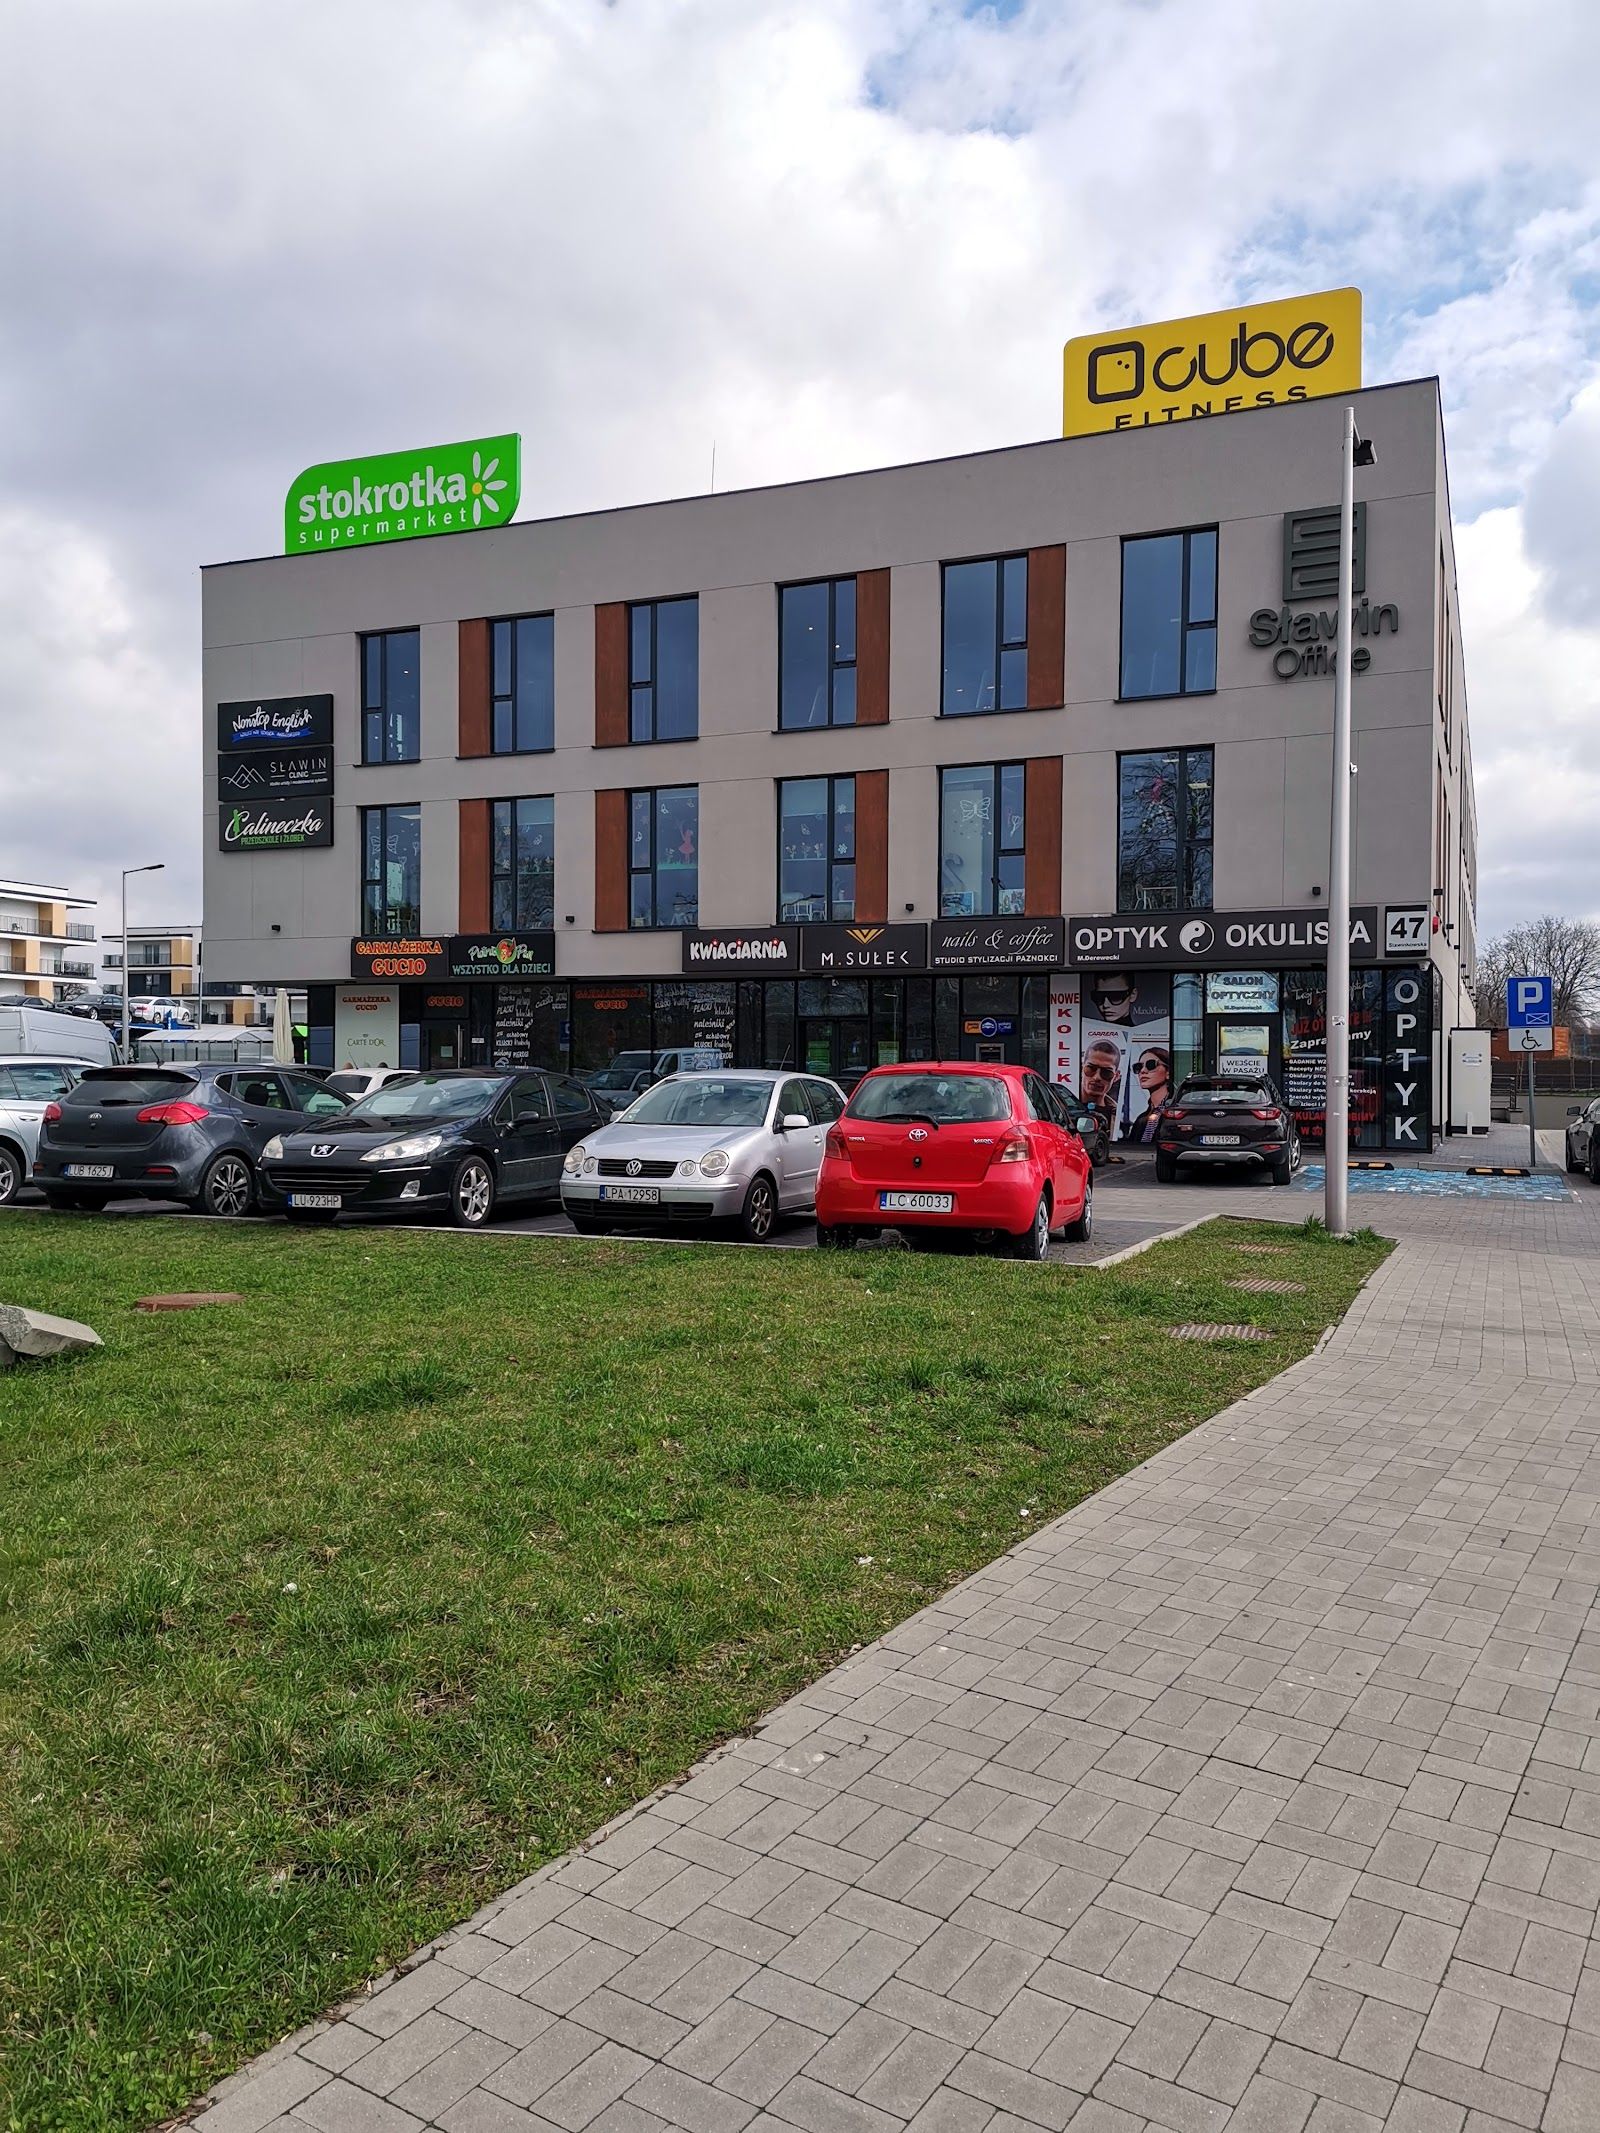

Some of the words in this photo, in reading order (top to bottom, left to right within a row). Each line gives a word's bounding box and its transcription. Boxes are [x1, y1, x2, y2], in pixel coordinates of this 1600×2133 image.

[1153, 321, 1334, 393] cube
[1115, 385, 1308, 429] FITNESS
[299, 465, 467, 524] stokrotka
[300, 507, 467, 544] supermarket
[232, 706, 269, 732] Nonstop
[272, 708, 312, 733] English
[270, 758, 327, 773] SŁAWIN
[288, 771, 309, 779] CLINIC
[224, 809, 325, 842] Calineczka
[1391, 917, 1424, 939] 47
[942, 929, 978, 948] nails
[984, 929, 1004, 949] &
[1008, 926, 1054, 955] coffee
[1074, 925, 1168, 951] OPTYK
[1225, 920, 1371, 948] OKULISA
[356, 938, 442, 955] GARMAŻERKA
[935, 956, 965, 964] STUDIO
[968, 955, 1013, 963] STYLIZACJI
[1016, 954, 1058, 962] PAZNOKCI
[371, 958, 427, 976] GUCIO
[452, 964, 499, 975] WSZYSTKO
[502, 963, 520, 974] DLA
[522, 962, 550, 974] DZIECI
[1223, 976, 1264, 986] SALON
[342, 994, 391, 1003] GARMAŻERKA
[427, 995, 464, 1007] GUCIO
[1050, 992, 1080, 1005] NOWE
[1211, 990, 1276, 1000] OPTYCZNY
[1517, 981, 1543, 1013] P
[693, 1017, 724, 1029] naleśniki
[1290, 1030, 1372, 1050] Zapramy
[1226, 1058, 1260, 1066] WEJŚCIE
[1394, 979, 1419, 1141] OPTYK
[1295, 1112, 1326, 1121] KULA
[1204, 1135, 1215, 1143] LU
[69, 1164, 85, 1176] LUB
[87, 1165, 112, 1177] 1625J
[294, 1195, 306, 1206] LU
[309, 1196, 339, 1206] 923HP
[605, 1188, 624, 1199] LPA
[628, 1189, 657, 1201] 12958
[889, 1194, 906, 1207] LC
[910, 1195, 949, 1208] 60033
